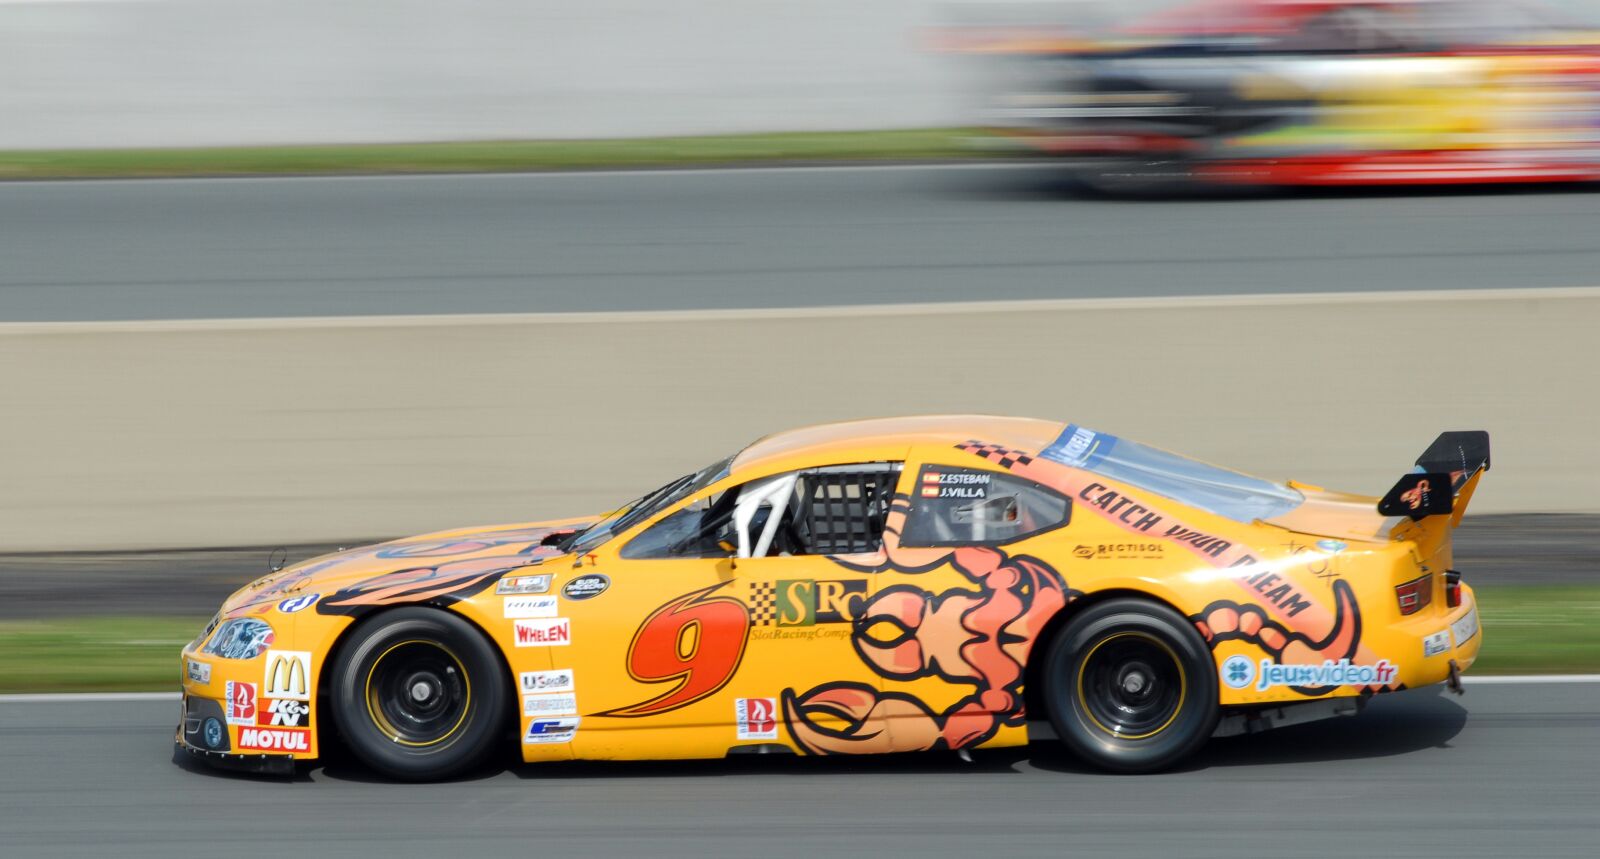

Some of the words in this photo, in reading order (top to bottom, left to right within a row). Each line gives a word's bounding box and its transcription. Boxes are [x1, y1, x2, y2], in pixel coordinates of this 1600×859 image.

[939, 473, 990, 485] Z.ESTEBAN
[939, 487, 985, 498] J.VILLA
[1079, 482, 1163, 532] CATCH
[1163, 524, 1231, 558] YOUR
[1097, 544, 1164, 554] RECTISOL
[516, 622, 568, 642] WHELEN
[583, 579, 751, 719] 9
[239, 728, 308, 750] MOTUL
